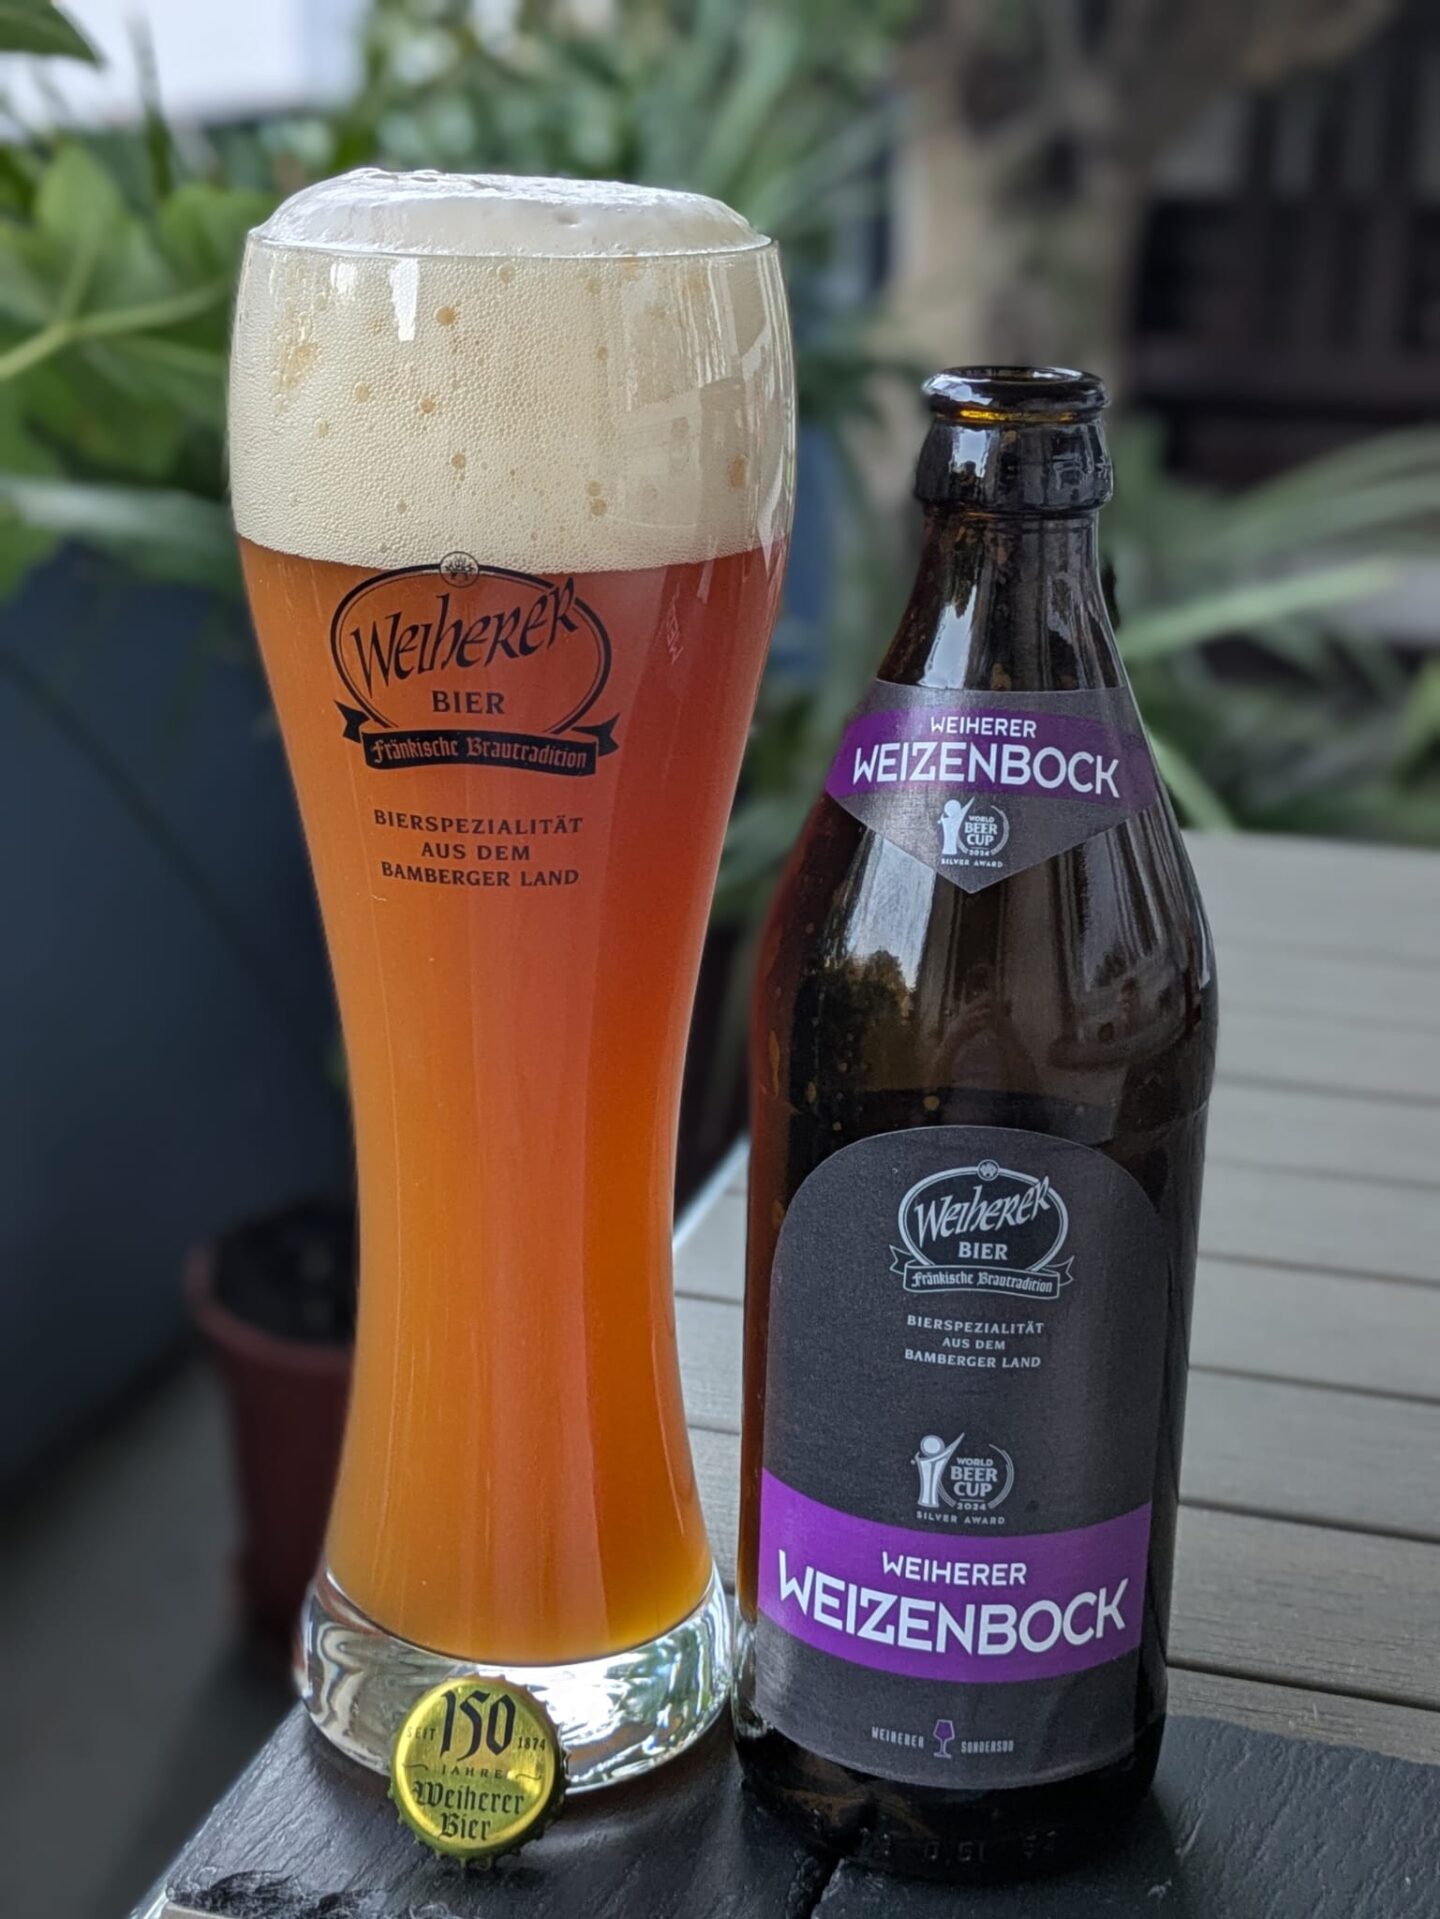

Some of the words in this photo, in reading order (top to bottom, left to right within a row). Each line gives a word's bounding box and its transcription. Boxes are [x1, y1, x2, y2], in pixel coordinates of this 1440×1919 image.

[432, 690, 505, 714] BIER
[931, 716, 1037, 738] WEIHERER
[371, 737, 459, 763] Fränkische
[466, 737, 587, 768] Brautradition
[853, 741, 1120, 798] WEIZENBOCK
[374, 809, 583, 835] BIERSPEZIALITÄT
[964, 822, 998, 835] BEER
[966, 834, 995, 846] CUP
[421, 842, 466, 860] AUS
[477, 845, 530, 861] DEM
[381, 861, 510, 887] BAMBERGER
[520, 869, 579, 886] LAND
[940, 858, 970, 866] SILVER
[973, 860, 1004, 868] AWARD
[958, 1241, 1008, 1261] BIER
[911, 1271, 973, 1288] Fränkische
[977, 1271, 1053, 1293] Brautradition
[907, 1315, 1045, 1334] BIERSPEZIALITÄT
[942, 1337, 970, 1349] AUS
[975, 1339, 1006, 1350] DEM
[904, 1348, 996, 1368] BAMBERGER
[1002, 1356, 1041, 1368] LAND
[956, 1457, 994, 1467] WORLD
[950, 1466, 998, 1482] BEER
[953, 1482, 993, 1497] CUP
[916, 1510, 958, 1524] SILVER
[964, 1515, 1005, 1525] AWARD
[882, 1551, 1027, 1586] WEIHERER
[778, 1549, 1130, 1656] WEIZENBOCK
[440, 1690, 516, 1762] 150
[406, 1726, 436, 1741] SEIT
[518, 1736, 546, 1751] 1874
[412, 1781, 525, 1814] Weiherer
[439, 1812, 492, 1841] Bier
